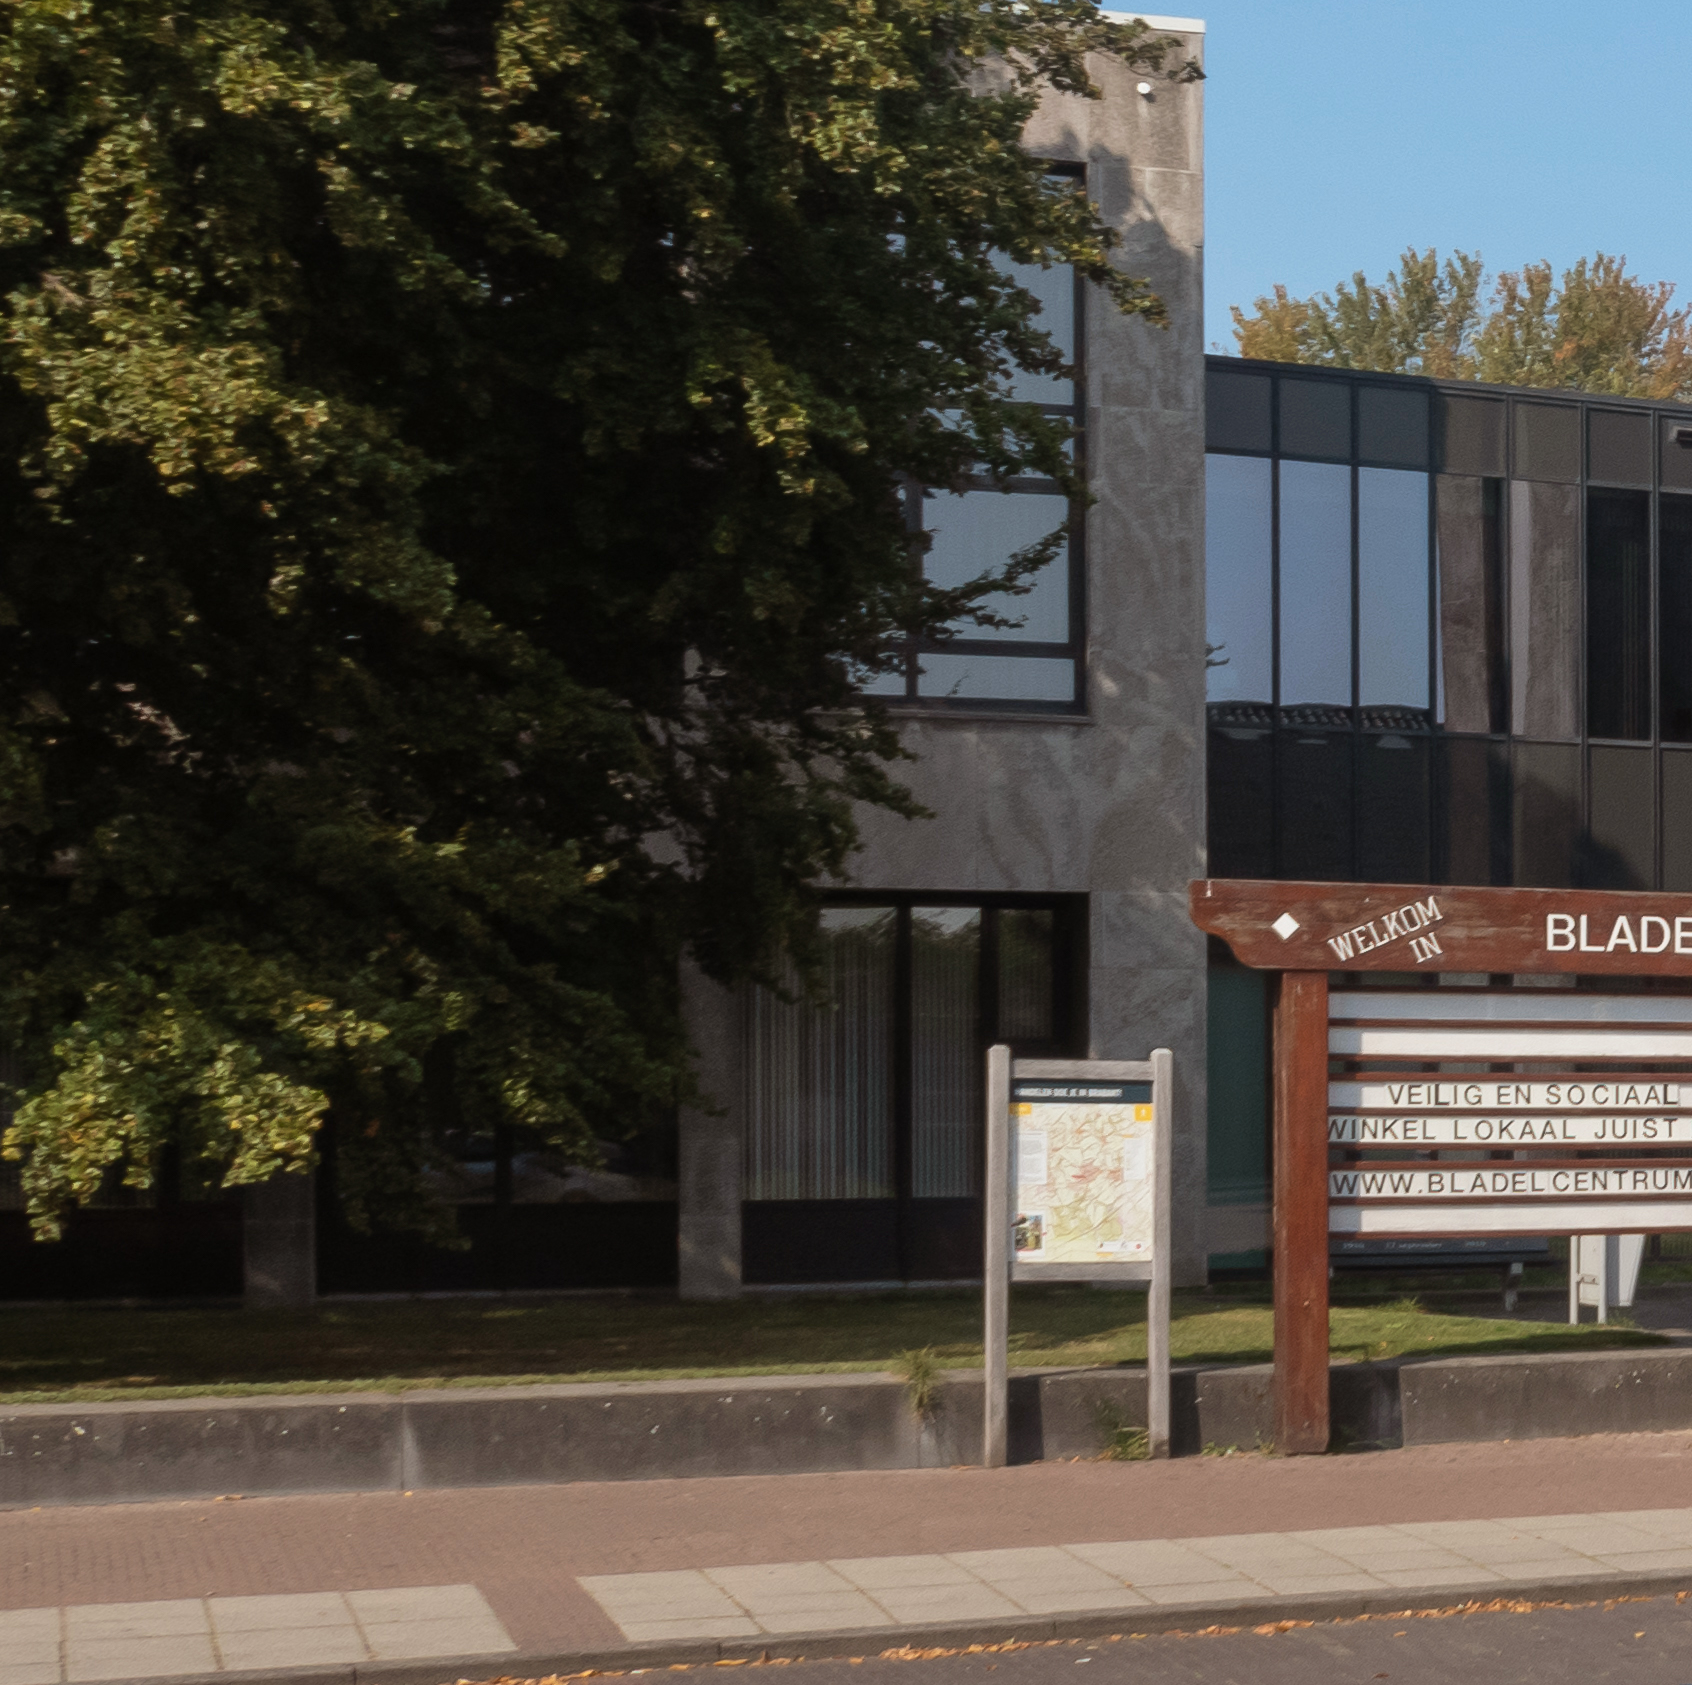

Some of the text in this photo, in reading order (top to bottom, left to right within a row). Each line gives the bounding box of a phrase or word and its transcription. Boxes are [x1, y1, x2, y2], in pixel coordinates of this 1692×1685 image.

[1327, 895, 1444, 962] WELKOM
[1408, 932, 1444, 964] IN
[1387, 1083, 1679, 1106] VEILIG EN SOCIAAL
[1328, 1119, 1437, 1141] WINKEL
[1453, 1118, 1576, 1140] LOKAAL
[1594, 1118, 1678, 1139] JUIST
